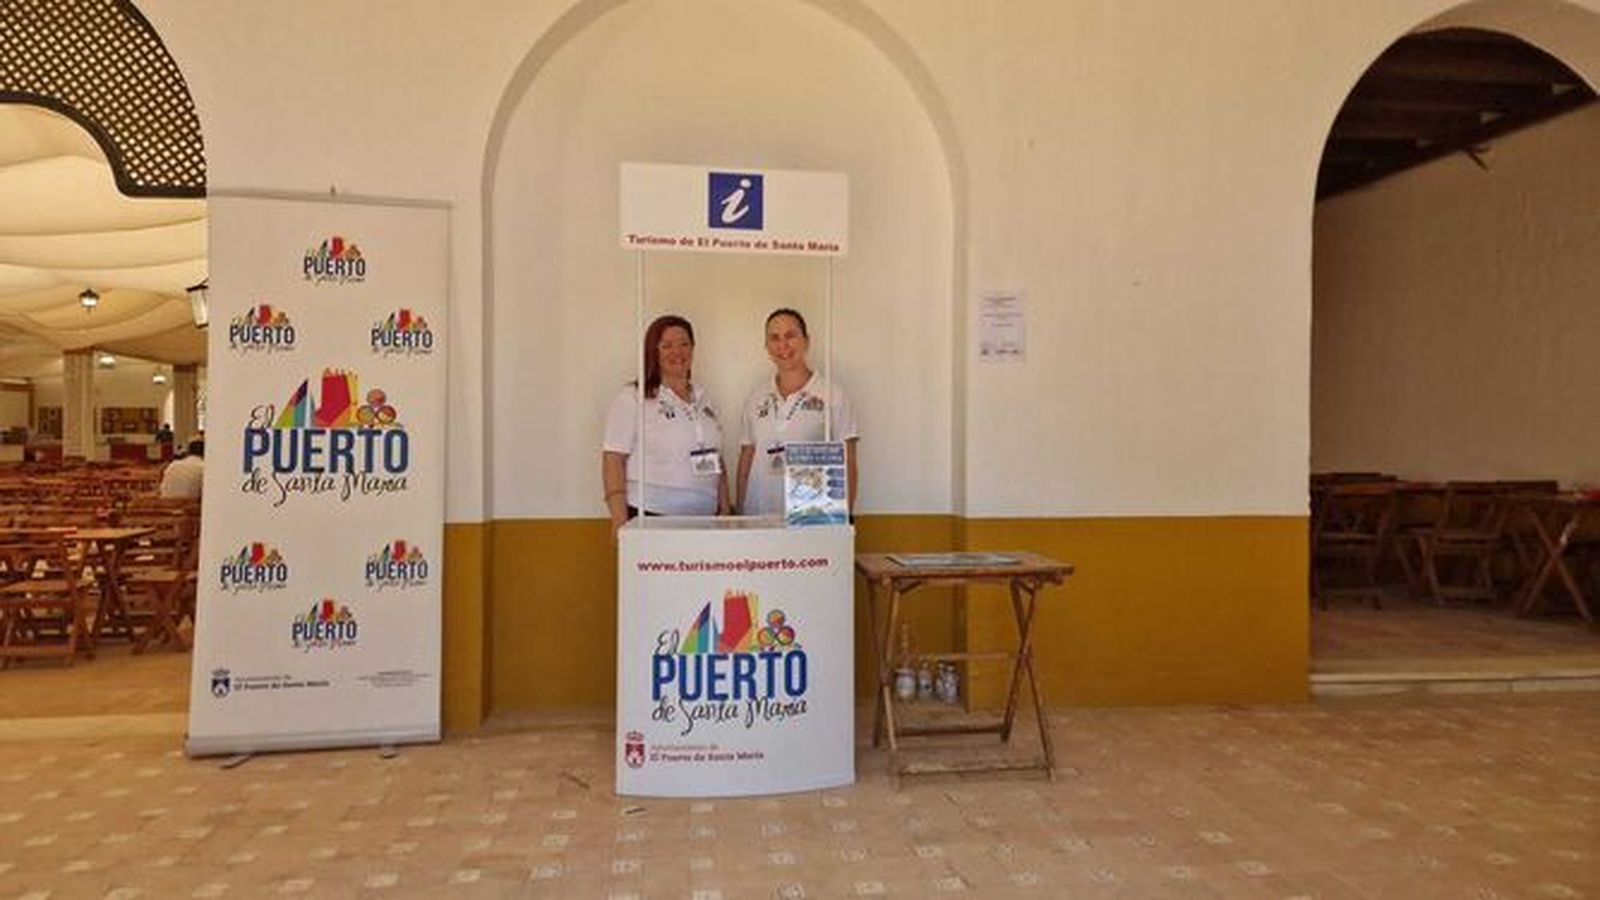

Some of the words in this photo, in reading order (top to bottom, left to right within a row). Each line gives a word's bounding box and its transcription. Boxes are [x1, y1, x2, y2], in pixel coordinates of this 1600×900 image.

[628, 234, 677, 246] Turismo
[680, 236, 694, 246] de
[698, 237, 710, 247] El
[712, 239, 751, 249] Puerto
[754, 240, 767, 249] de
[772, 240, 804, 250] Santa
[303, 257, 366, 277] PUERTO
[229, 325, 295, 344] PUERTO
[371, 328, 433, 348] PUERTO
[249, 404, 275, 430] El
[243, 428, 409, 474] PUERTO
[242, 467, 268, 494] de
[272, 470, 335, 508] Santa
[220, 563, 288, 584] PUERTO
[365, 560, 429, 581] PUERTO
[637, 557, 828, 571] www.turismoelpuerto.com
[292, 620, 357, 641] PUERTO
[656, 628, 680, 656] El
[652, 650, 807, 702] PUERTO
[652, 696, 675, 721] de
[679, 698, 739, 736] Santa
